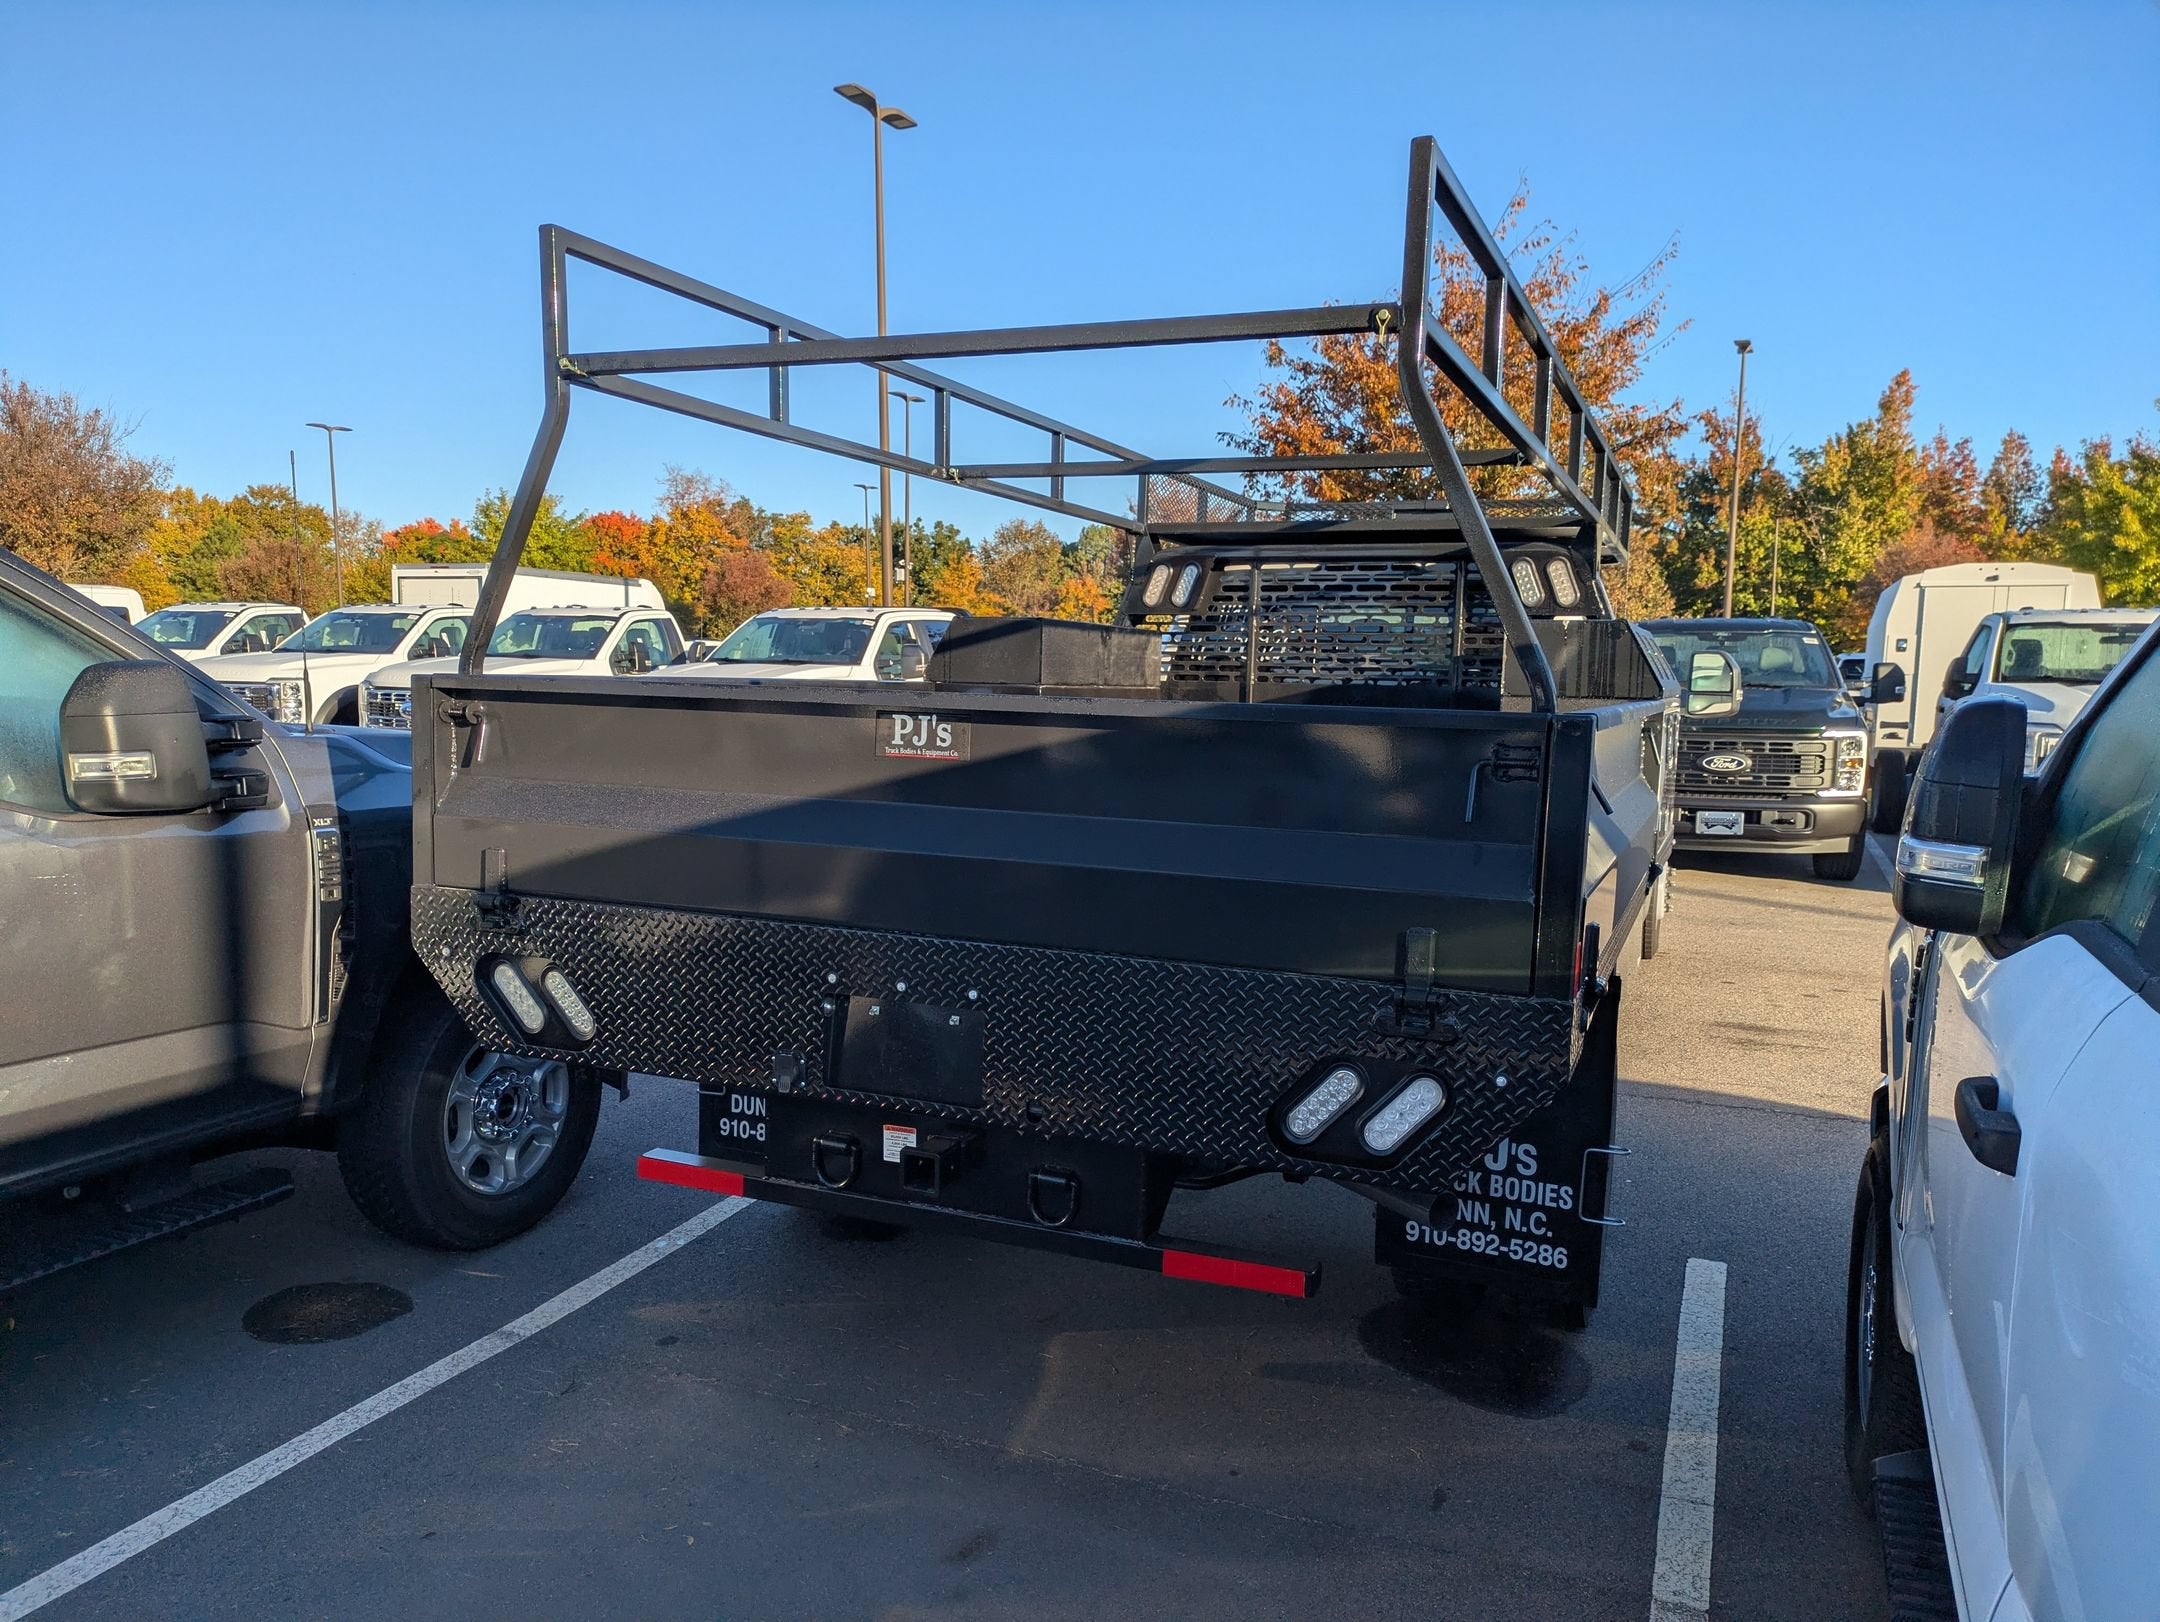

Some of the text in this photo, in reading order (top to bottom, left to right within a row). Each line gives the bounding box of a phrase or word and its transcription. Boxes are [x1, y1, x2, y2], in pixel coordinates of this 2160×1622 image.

[891, 714, 952, 747] PJ's
[885, 746, 899, 754] Truck
[900, 747, 917, 755] Bodies
[922, 748, 950, 758] Equipment
[1710, 758, 1738, 769] Ford
[313, 817, 333, 827] XLT
[1489, 1174, 1574, 1210] BODIES
[1504, 1207, 1553, 1238] N.C.
[1405, 1220, 1569, 1269] 910-892-5286
